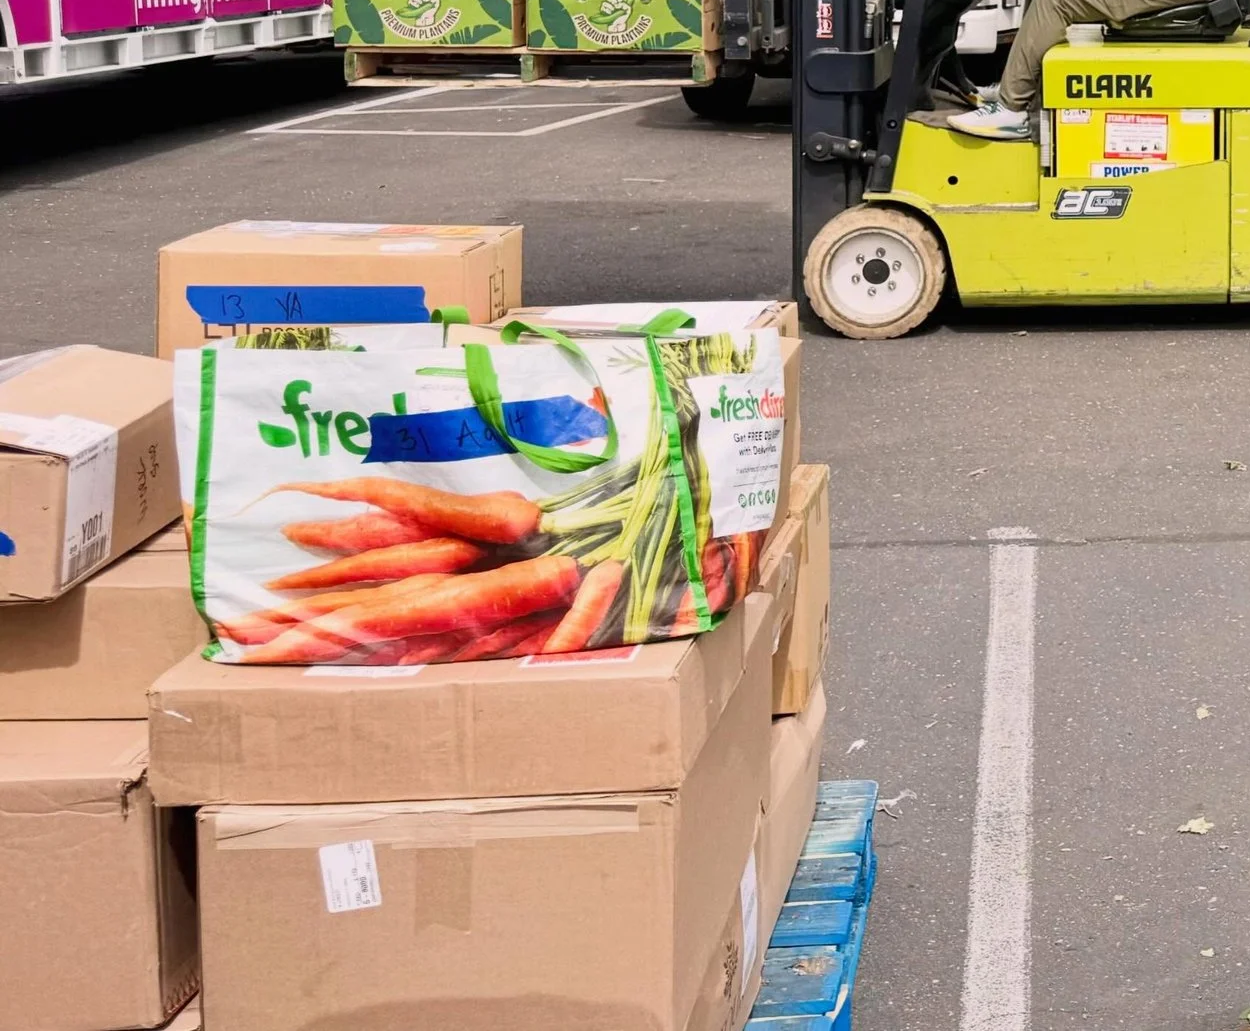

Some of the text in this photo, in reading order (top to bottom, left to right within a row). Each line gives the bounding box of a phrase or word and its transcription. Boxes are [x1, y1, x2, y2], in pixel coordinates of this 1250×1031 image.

[380, 9, 460, 40] PREMIUM PLANTAINS
[574, 15, 652, 46] PREMIUM PLANTAINS
[1066, 74, 1153, 99] CLARK
[221, 294, 246, 320] 13
